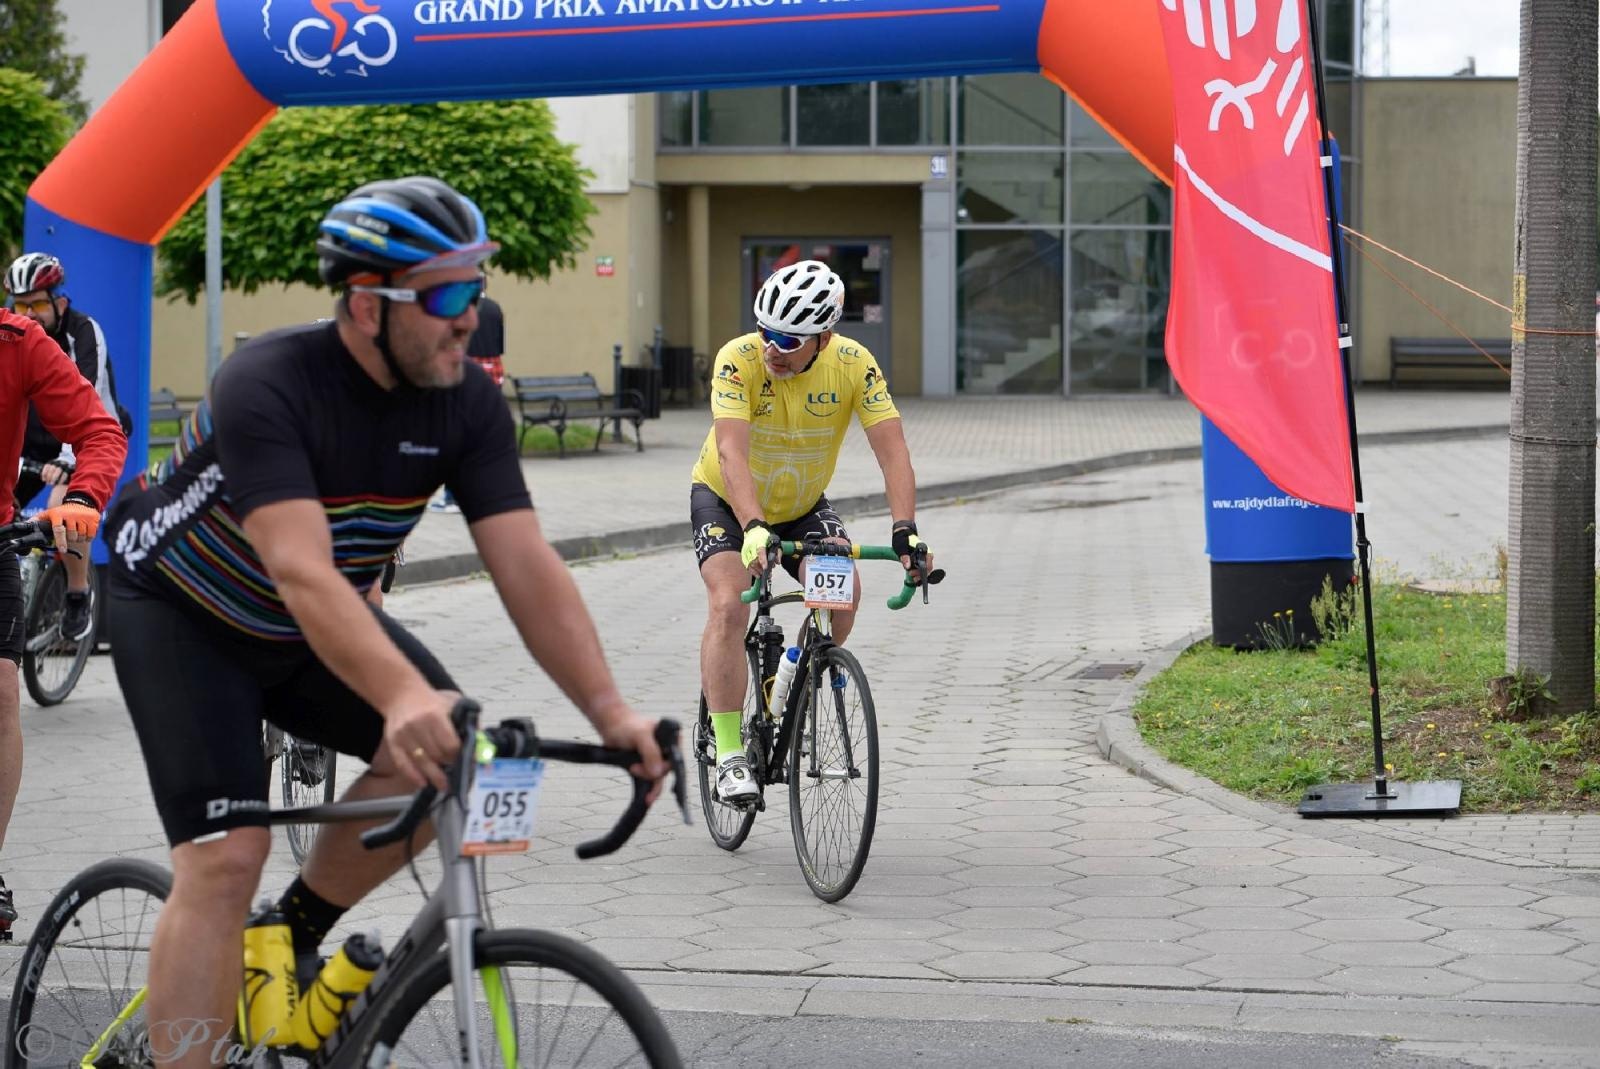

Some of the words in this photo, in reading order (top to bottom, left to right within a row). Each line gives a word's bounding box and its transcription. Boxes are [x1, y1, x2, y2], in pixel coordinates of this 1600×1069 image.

[414, 0, 524, 25] GRAND
[534, 0, 606, 19] PRIX
[738, 343, 758, 354] LCL
[839, 345, 861, 358] LCL
[807, 391, 841, 404] LCL
[866, 390, 891, 405] LCL
[1212, 496, 1320, 511] www.rajdydlafraj
[814, 573, 846, 589] 057
[483, 791, 528, 818] 055
